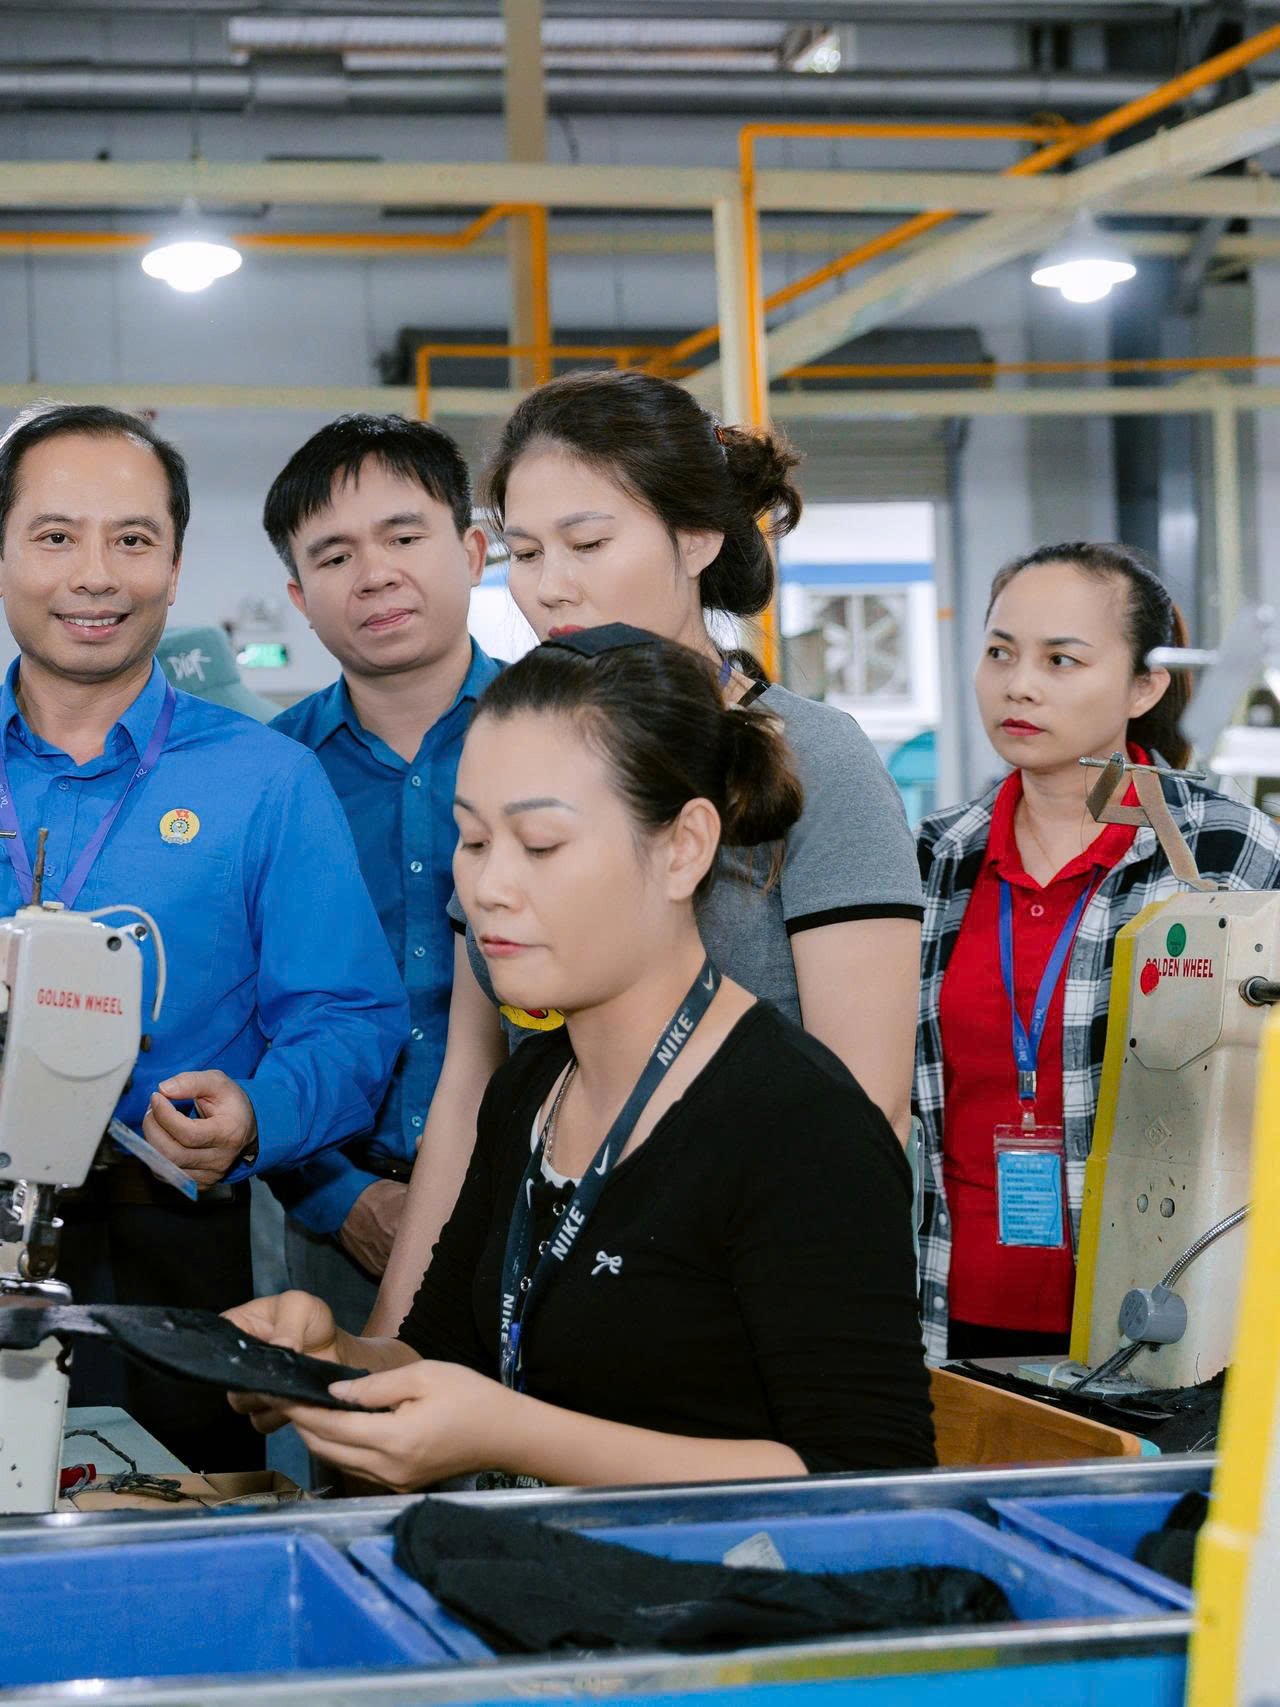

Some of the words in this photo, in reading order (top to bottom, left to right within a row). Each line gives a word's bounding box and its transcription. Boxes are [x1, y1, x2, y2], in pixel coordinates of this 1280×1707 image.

[1182, 958, 1214, 978] WHEEL
[37, 988, 81, 1009] GOLDEN
[84, 994, 123, 1015] WHEEL
[656, 1012, 694, 1067] NIKE
[551, 1205, 585, 1261] NIKE
[500, 1293, 515, 1343] NIKE
